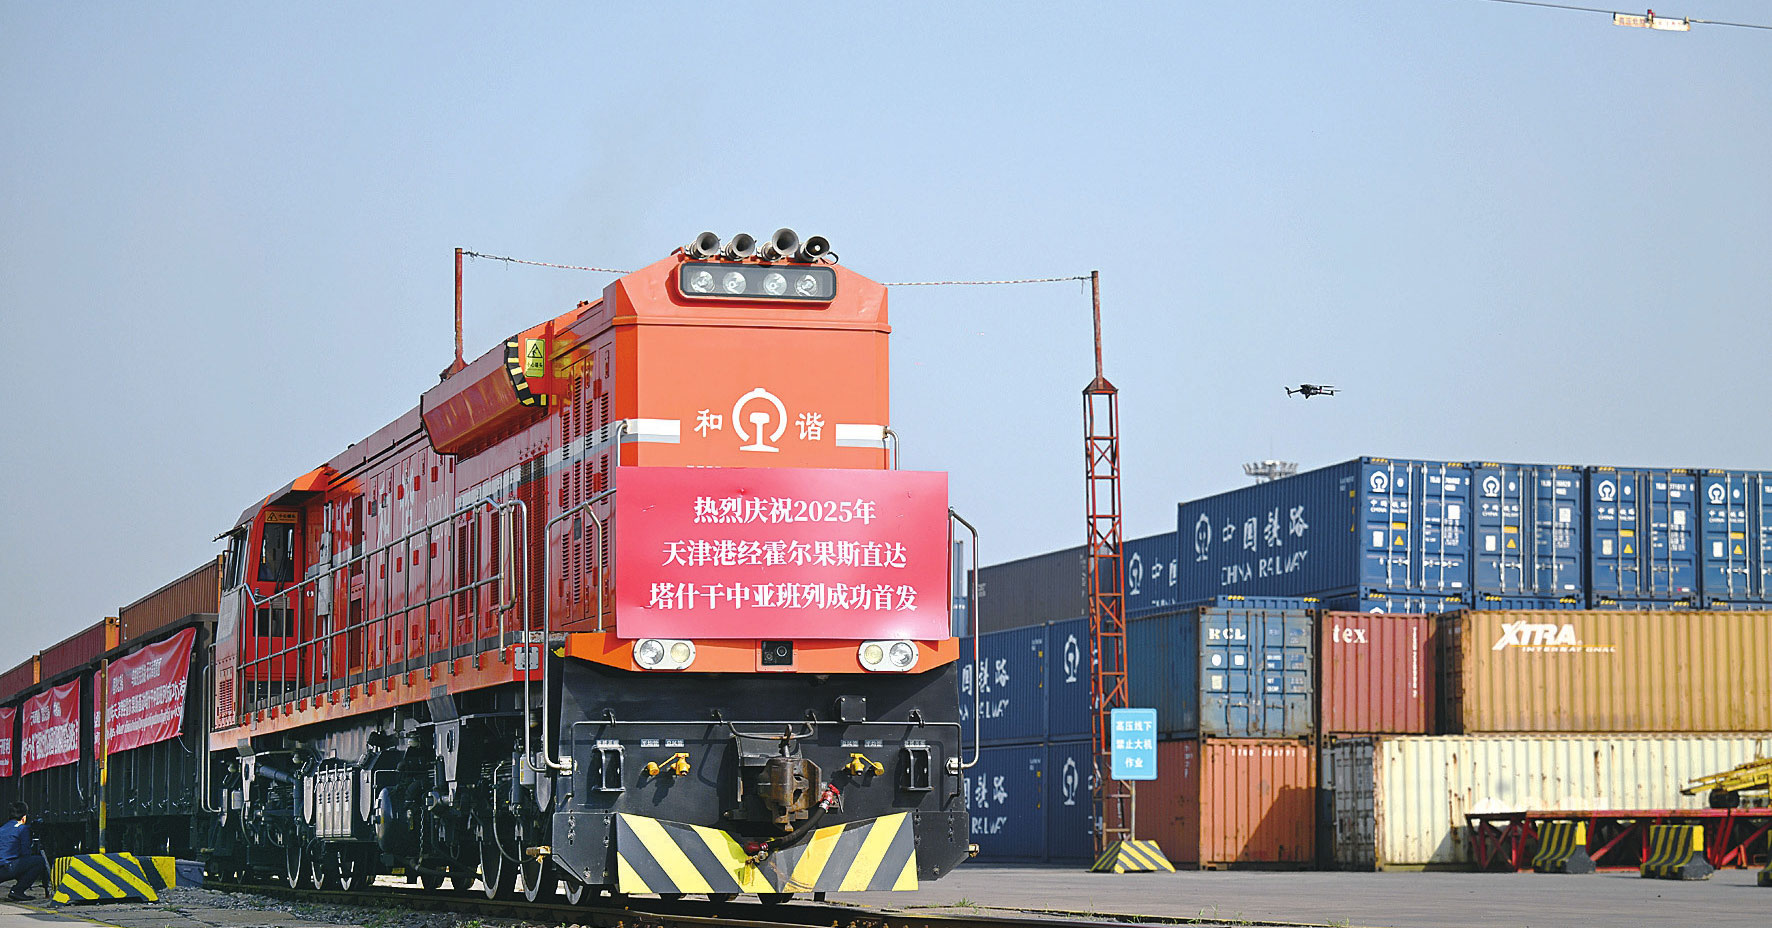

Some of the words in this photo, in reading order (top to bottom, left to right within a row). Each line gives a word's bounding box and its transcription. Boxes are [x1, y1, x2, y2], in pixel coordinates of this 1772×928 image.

[694, 409, 723, 437] 和
[795, 412, 825, 441] 谐
[693, 497, 876, 525] 热烈庆祝2025年
[662, 540, 907, 568] 天津港经霍尔果斯直达
[1221, 562, 1252, 586] CHNA
[1259, 550, 1308, 578] RALWAY
[650, 583, 918, 612] 塔什干中亚班列成功首发
[1208, 628, 1247, 640] RCL
[1492, 620, 1577, 650] XTRA
[971, 816, 1007, 835] RALWAY
